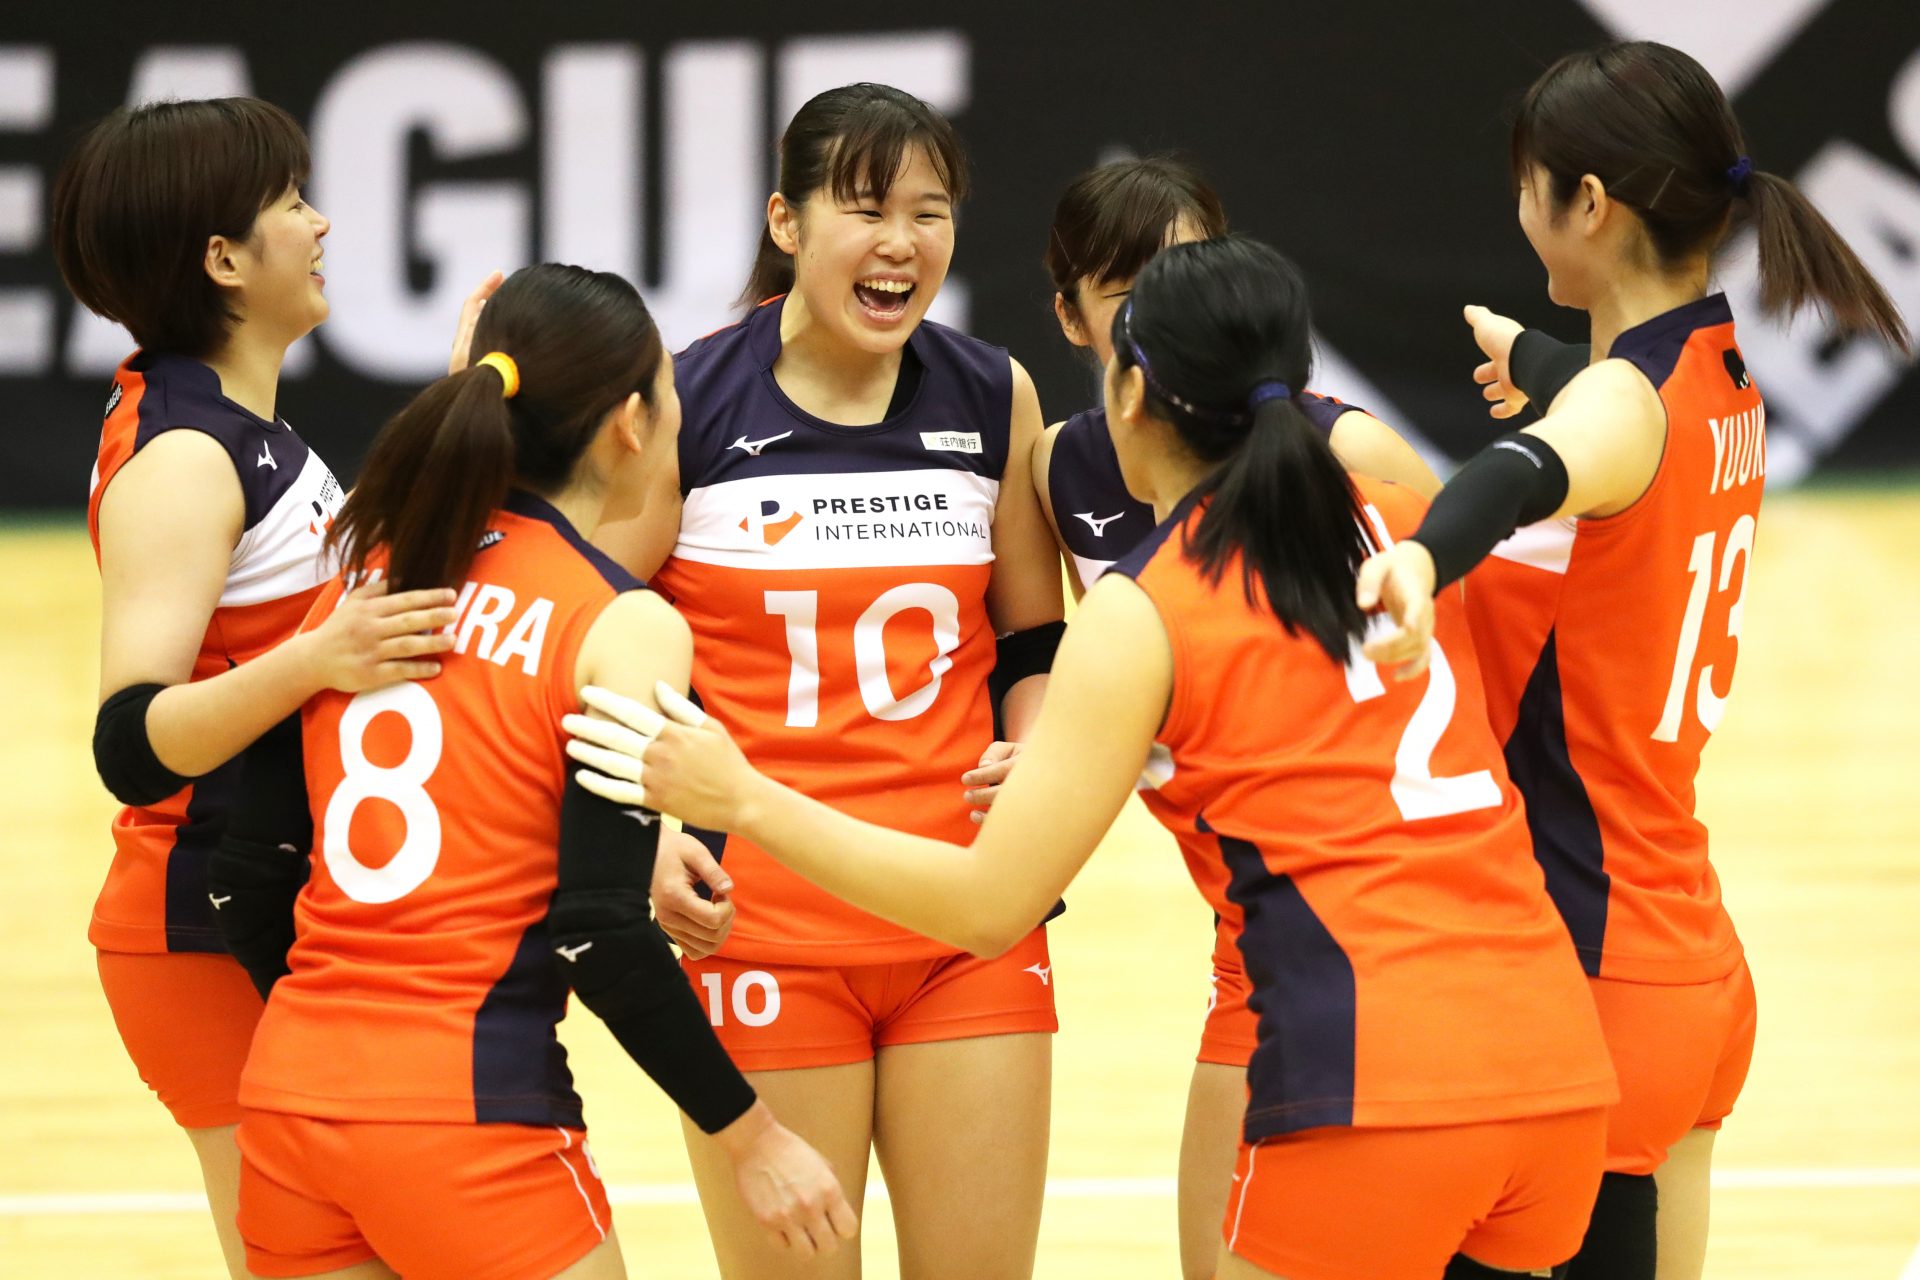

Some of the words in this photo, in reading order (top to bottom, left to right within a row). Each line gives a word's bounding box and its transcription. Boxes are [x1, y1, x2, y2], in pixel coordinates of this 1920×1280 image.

[1708, 398, 1767, 494] YUUK
[812, 494, 949, 514] PRESTIGE
[815, 520, 987, 541] INTERNATIONAL
[764, 582, 960, 728] 10
[1650, 514, 1756, 742] 13
[323, 680, 443, 904] 8
[701, 970, 781, 1028] 10
